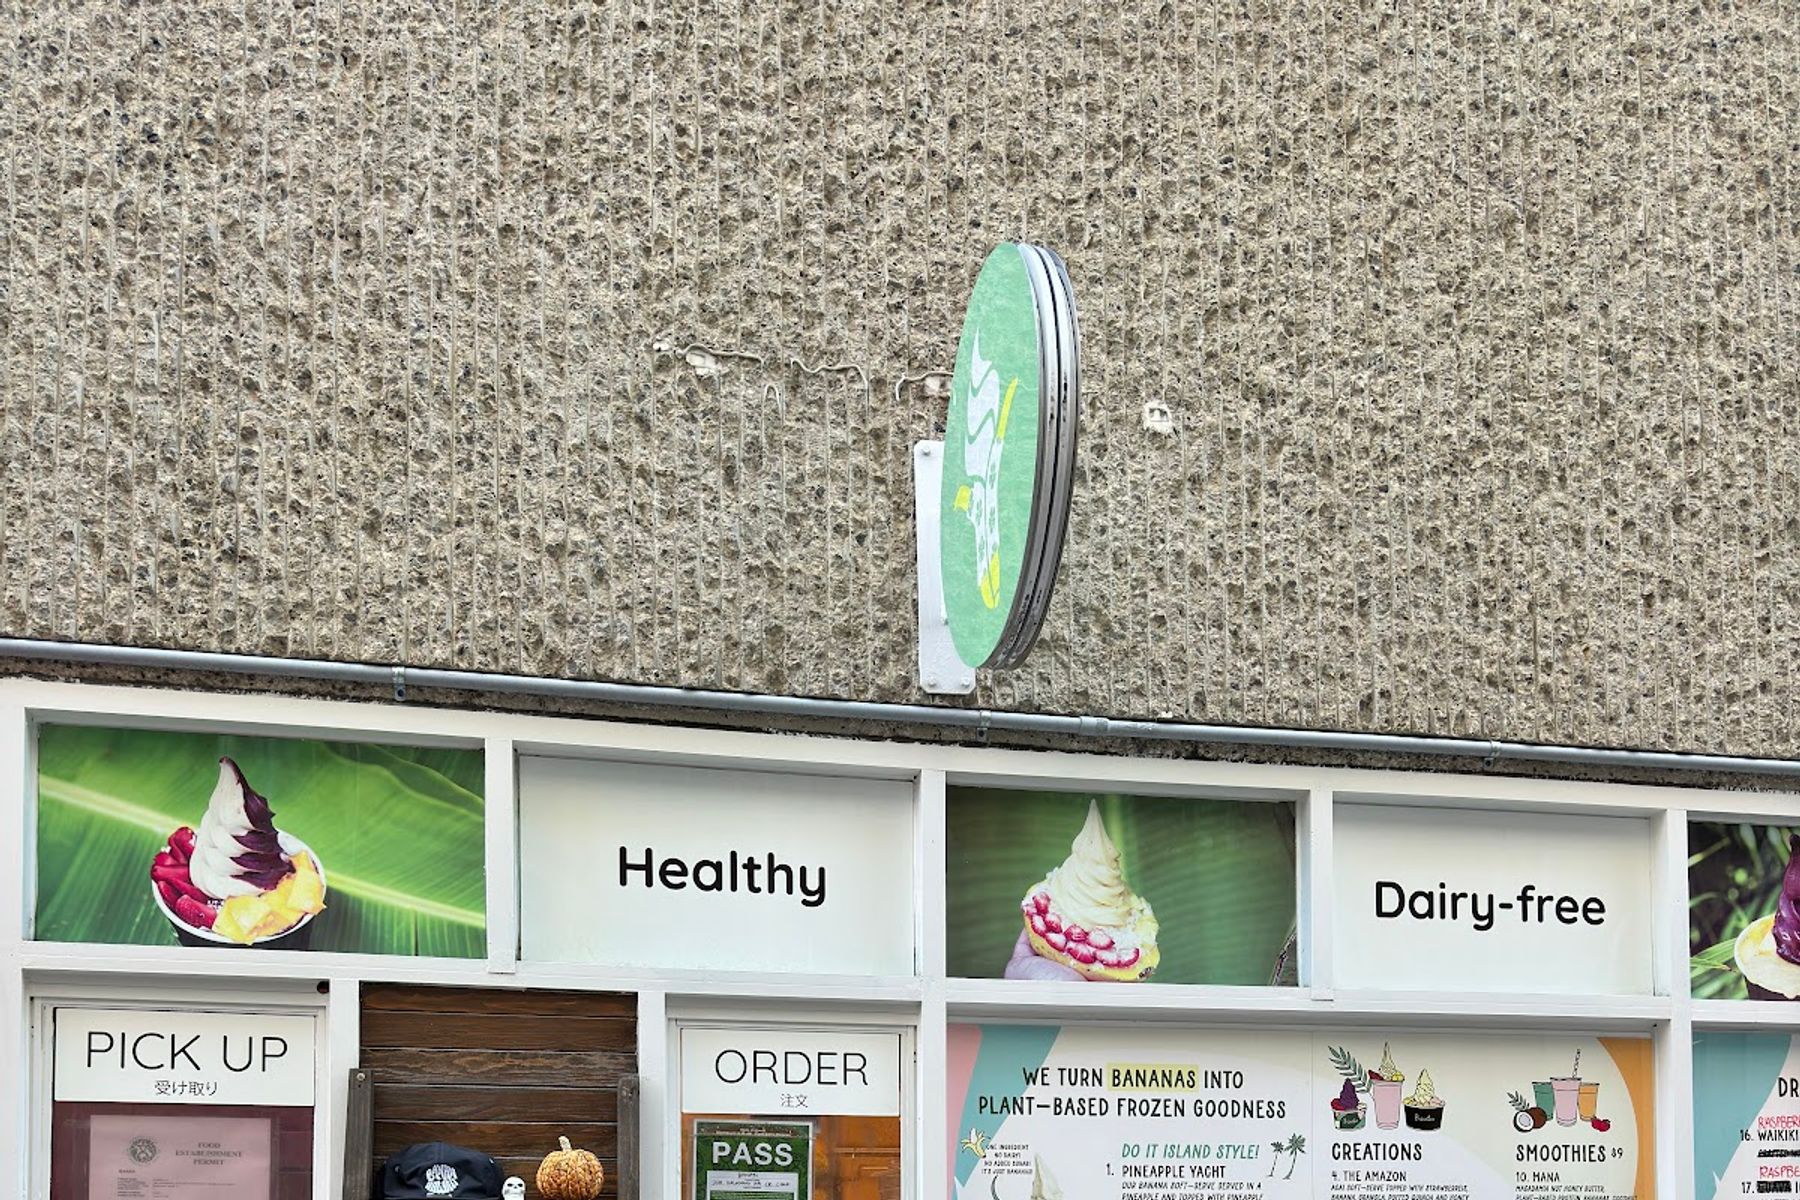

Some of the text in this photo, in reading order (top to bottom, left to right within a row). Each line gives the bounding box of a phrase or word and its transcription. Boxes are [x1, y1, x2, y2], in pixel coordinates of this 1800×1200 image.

[618, 845, 826, 907] Healthy
[1375, 880, 1606, 931] Dairy-free
[86, 1031, 289, 1073] PICK UP
[715, 1049, 868, 1086] ORDER
[1022, 1067, 1244, 1089] WE TURN BANANAS INTO
[154, 1080, 218, 1097] 受け取り
[780, 1093, 808, 1109] 注文
[1117, 1097, 1186, 1118] FROZEN
[1193, 1099, 1286, 1119] GOODNESS
[1740, 1129, 1799, 1141] 16. WAIKIKI
[712, 1141, 793, 1167] PASS
[1121, 1143, 1260, 1160] DO IT ISLAND STYLE!
[1331, 1142, 1422, 1161] CREATIONS
[1516, 1144, 1606, 1163] SMOOTHIES
[1106, 1163, 1226, 1179] 1. PINEAPPLE YACHT
[1331, 1170, 1407, 1182] 4. THE AMAZON
[1516, 1171, 1530, 1183] 10.
[1741, 1181, 1755, 1194] 17.
